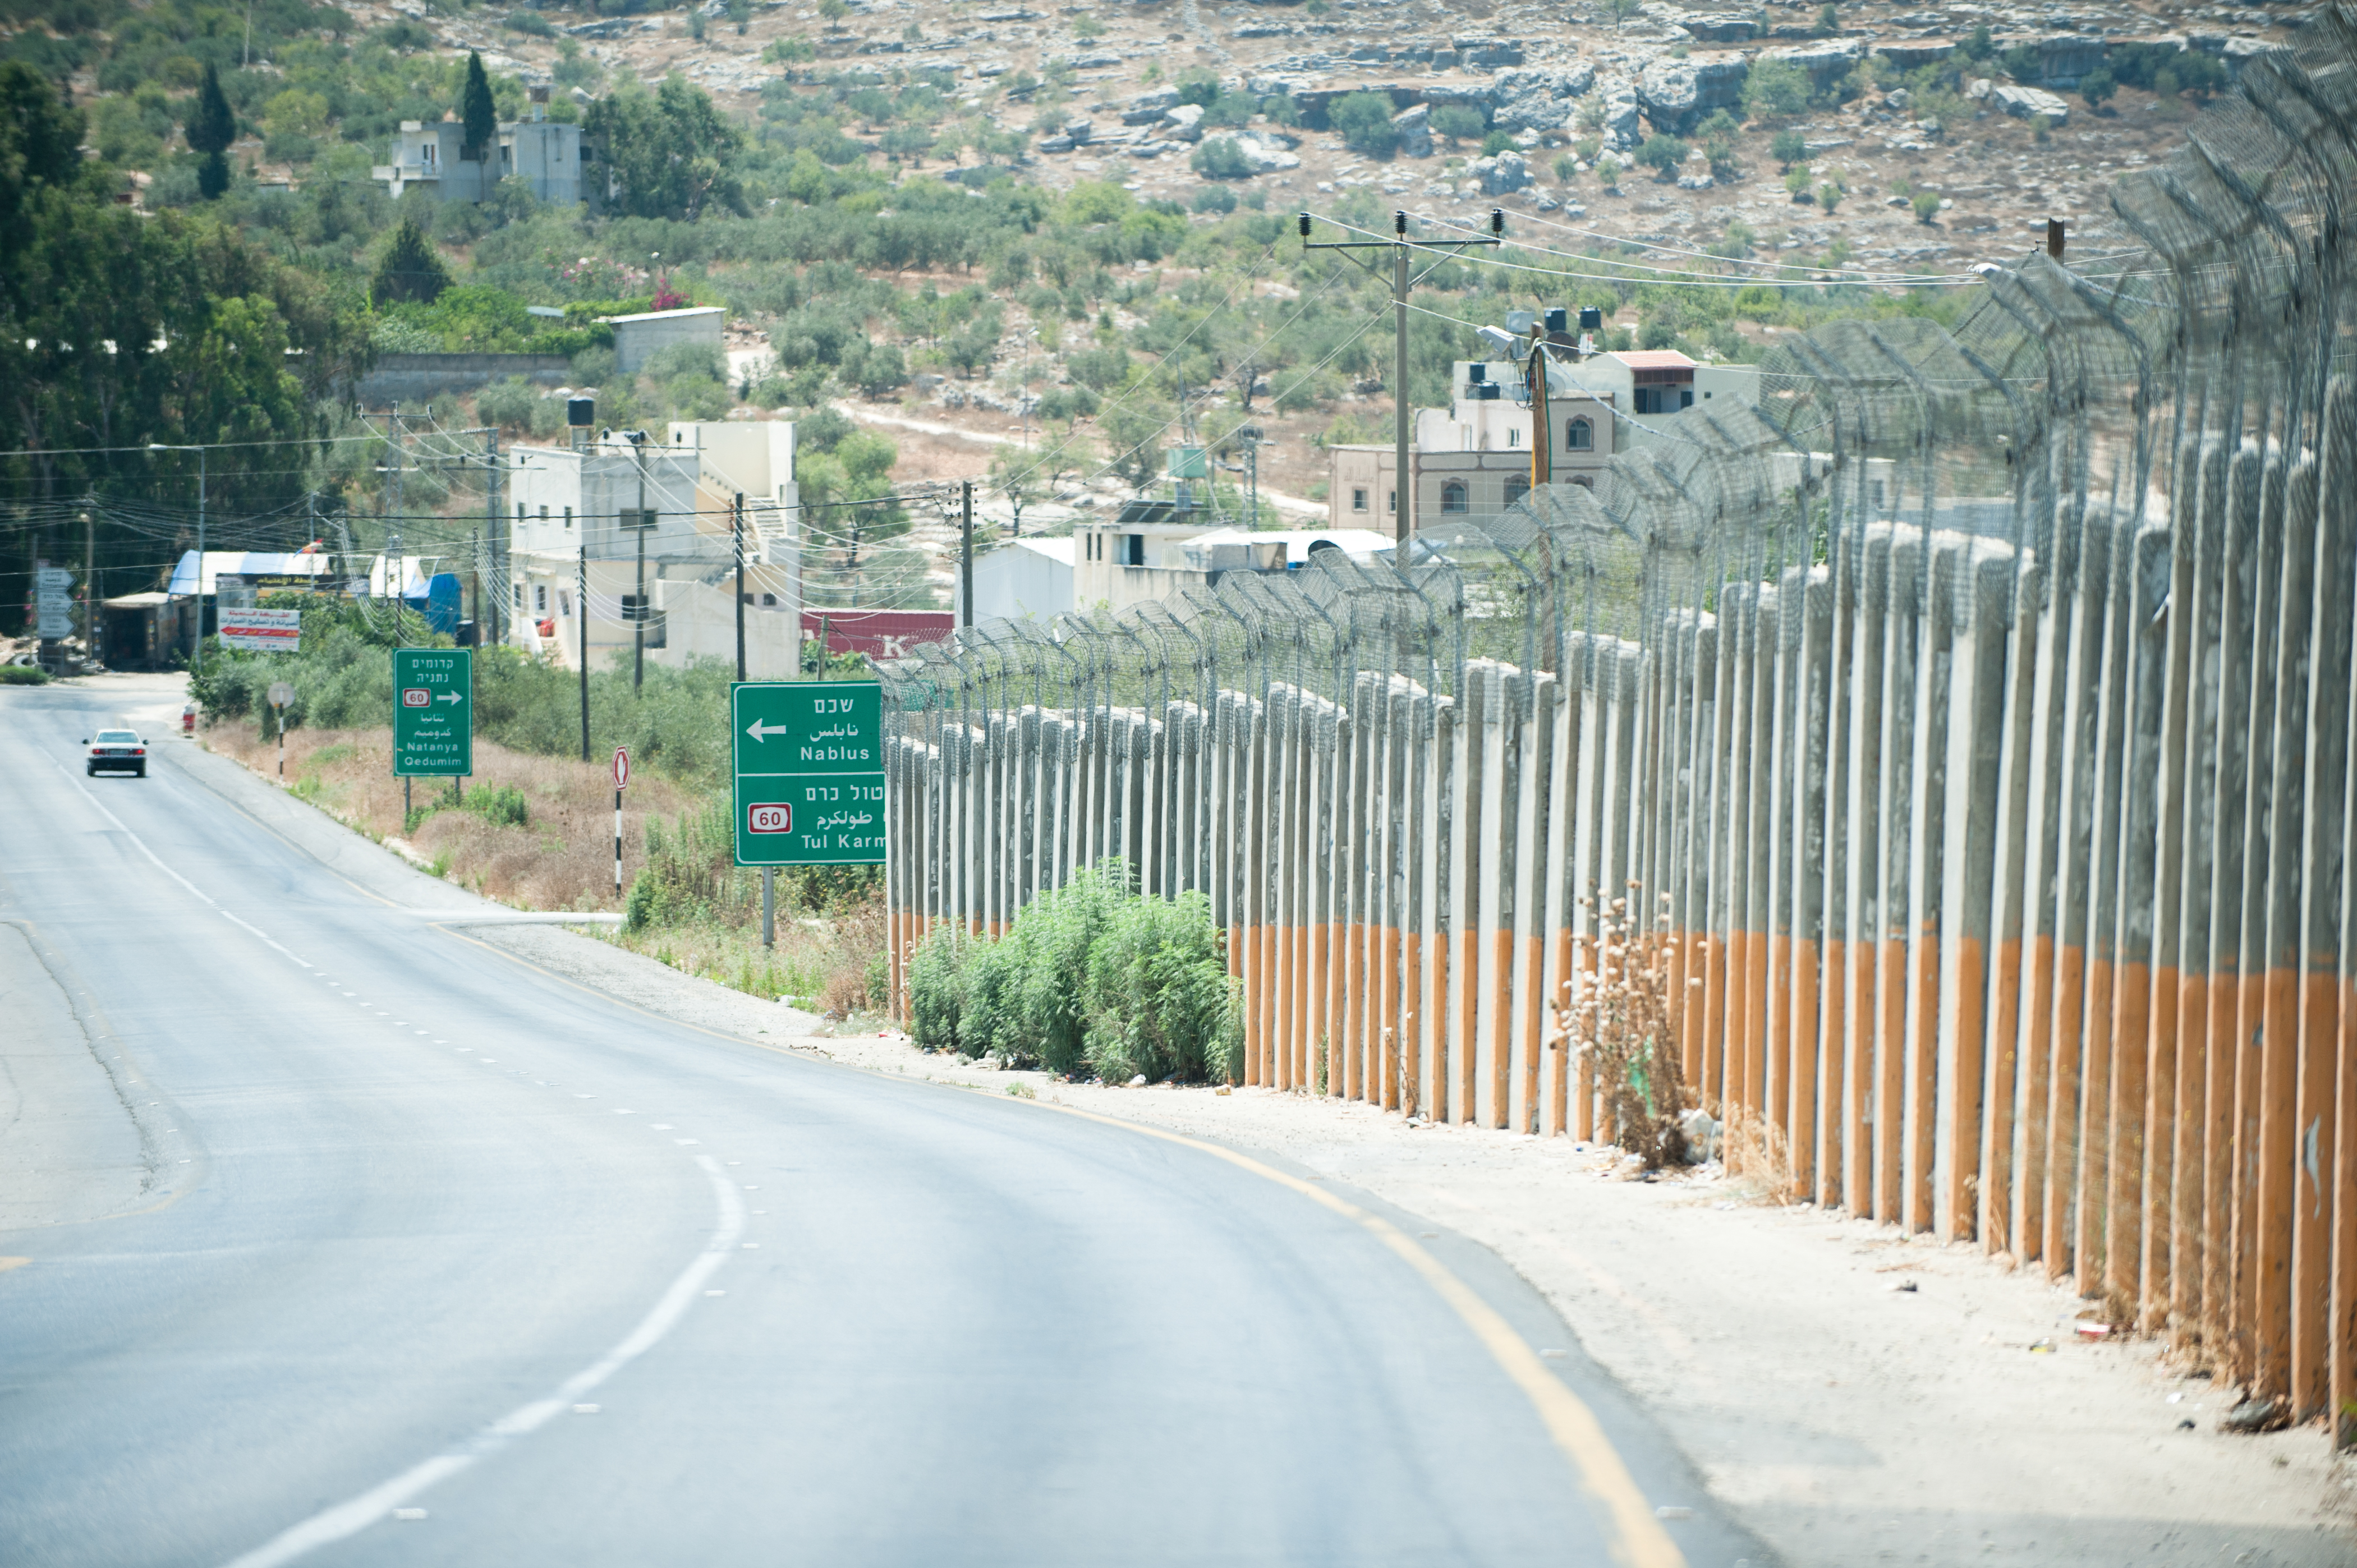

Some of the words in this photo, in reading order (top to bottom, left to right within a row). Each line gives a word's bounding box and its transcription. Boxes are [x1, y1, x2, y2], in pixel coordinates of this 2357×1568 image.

[412, 659, 453, 669] קדומים
[417, 673, 449, 683] נתניה
[410, 693, 424, 702] 60
[814, 699, 853, 714] שכם
[810, 723, 858, 742] نابلس
[407, 742, 458, 753] Natanya
[801, 746, 869, 761] Nablus
[404, 756, 461, 766] Qedumim
[805, 787, 839, 801] כרם
[850, 784, 883, 801] טול
[759, 812, 781, 826] 60
[817, 810, 872, 830] طولكرم
[801, 834, 827, 849] Tul
